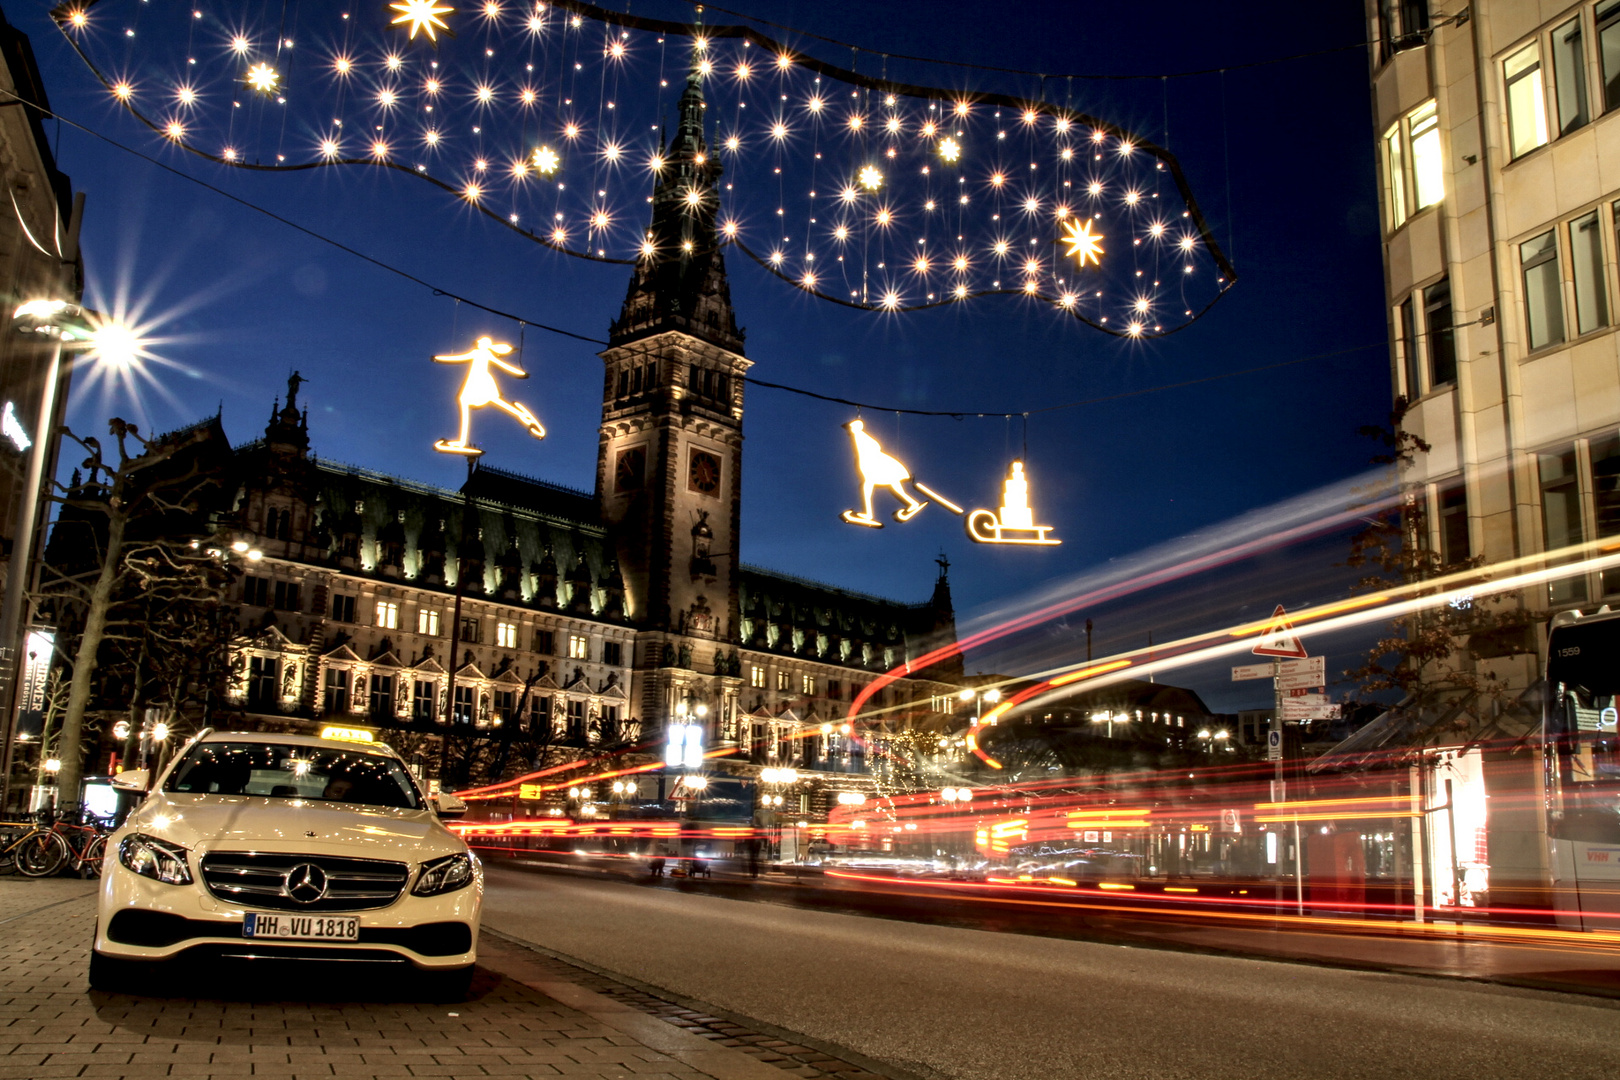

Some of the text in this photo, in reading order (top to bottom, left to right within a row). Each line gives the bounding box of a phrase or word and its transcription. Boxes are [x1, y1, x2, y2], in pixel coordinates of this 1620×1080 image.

[1557, 646, 1580, 657] 1559
[31, 660, 48, 711] HIRMER
[1587, 851, 1609, 861] VHH
[256, 916, 357, 938] HH VU 1818
